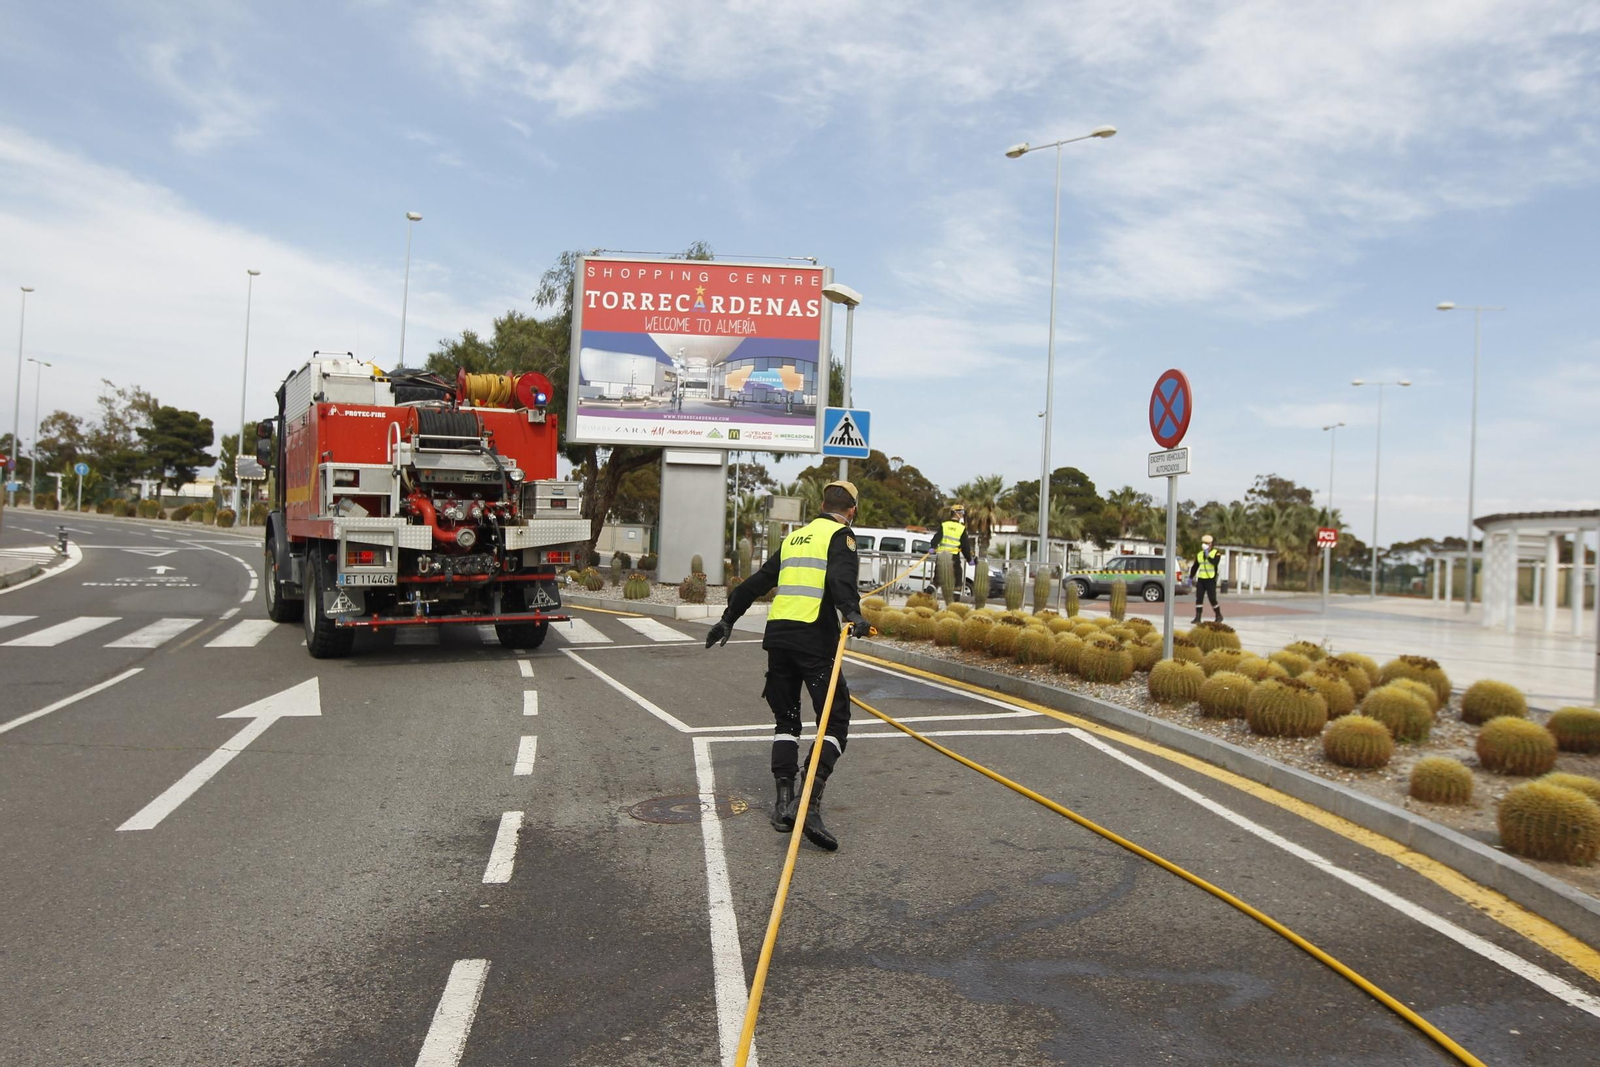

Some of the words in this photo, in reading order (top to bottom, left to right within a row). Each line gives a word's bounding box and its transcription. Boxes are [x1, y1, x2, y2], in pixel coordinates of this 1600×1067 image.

[587, 267, 709, 283] SHOPPING
[729, 272, 819, 286] CENTRE
[585, 288, 819, 317] TORRECARDENAS
[645, 316, 691, 332] WELCOME
[696, 318, 711, 333] TO
[716, 317, 757, 335] ALMERÍA
[344, 410, 386, 419] PROTEC-FIRE
[615, 426, 647, 434] ZARA
[345, 575, 357, 585] ET
[361, 574, 395, 585] 114464
